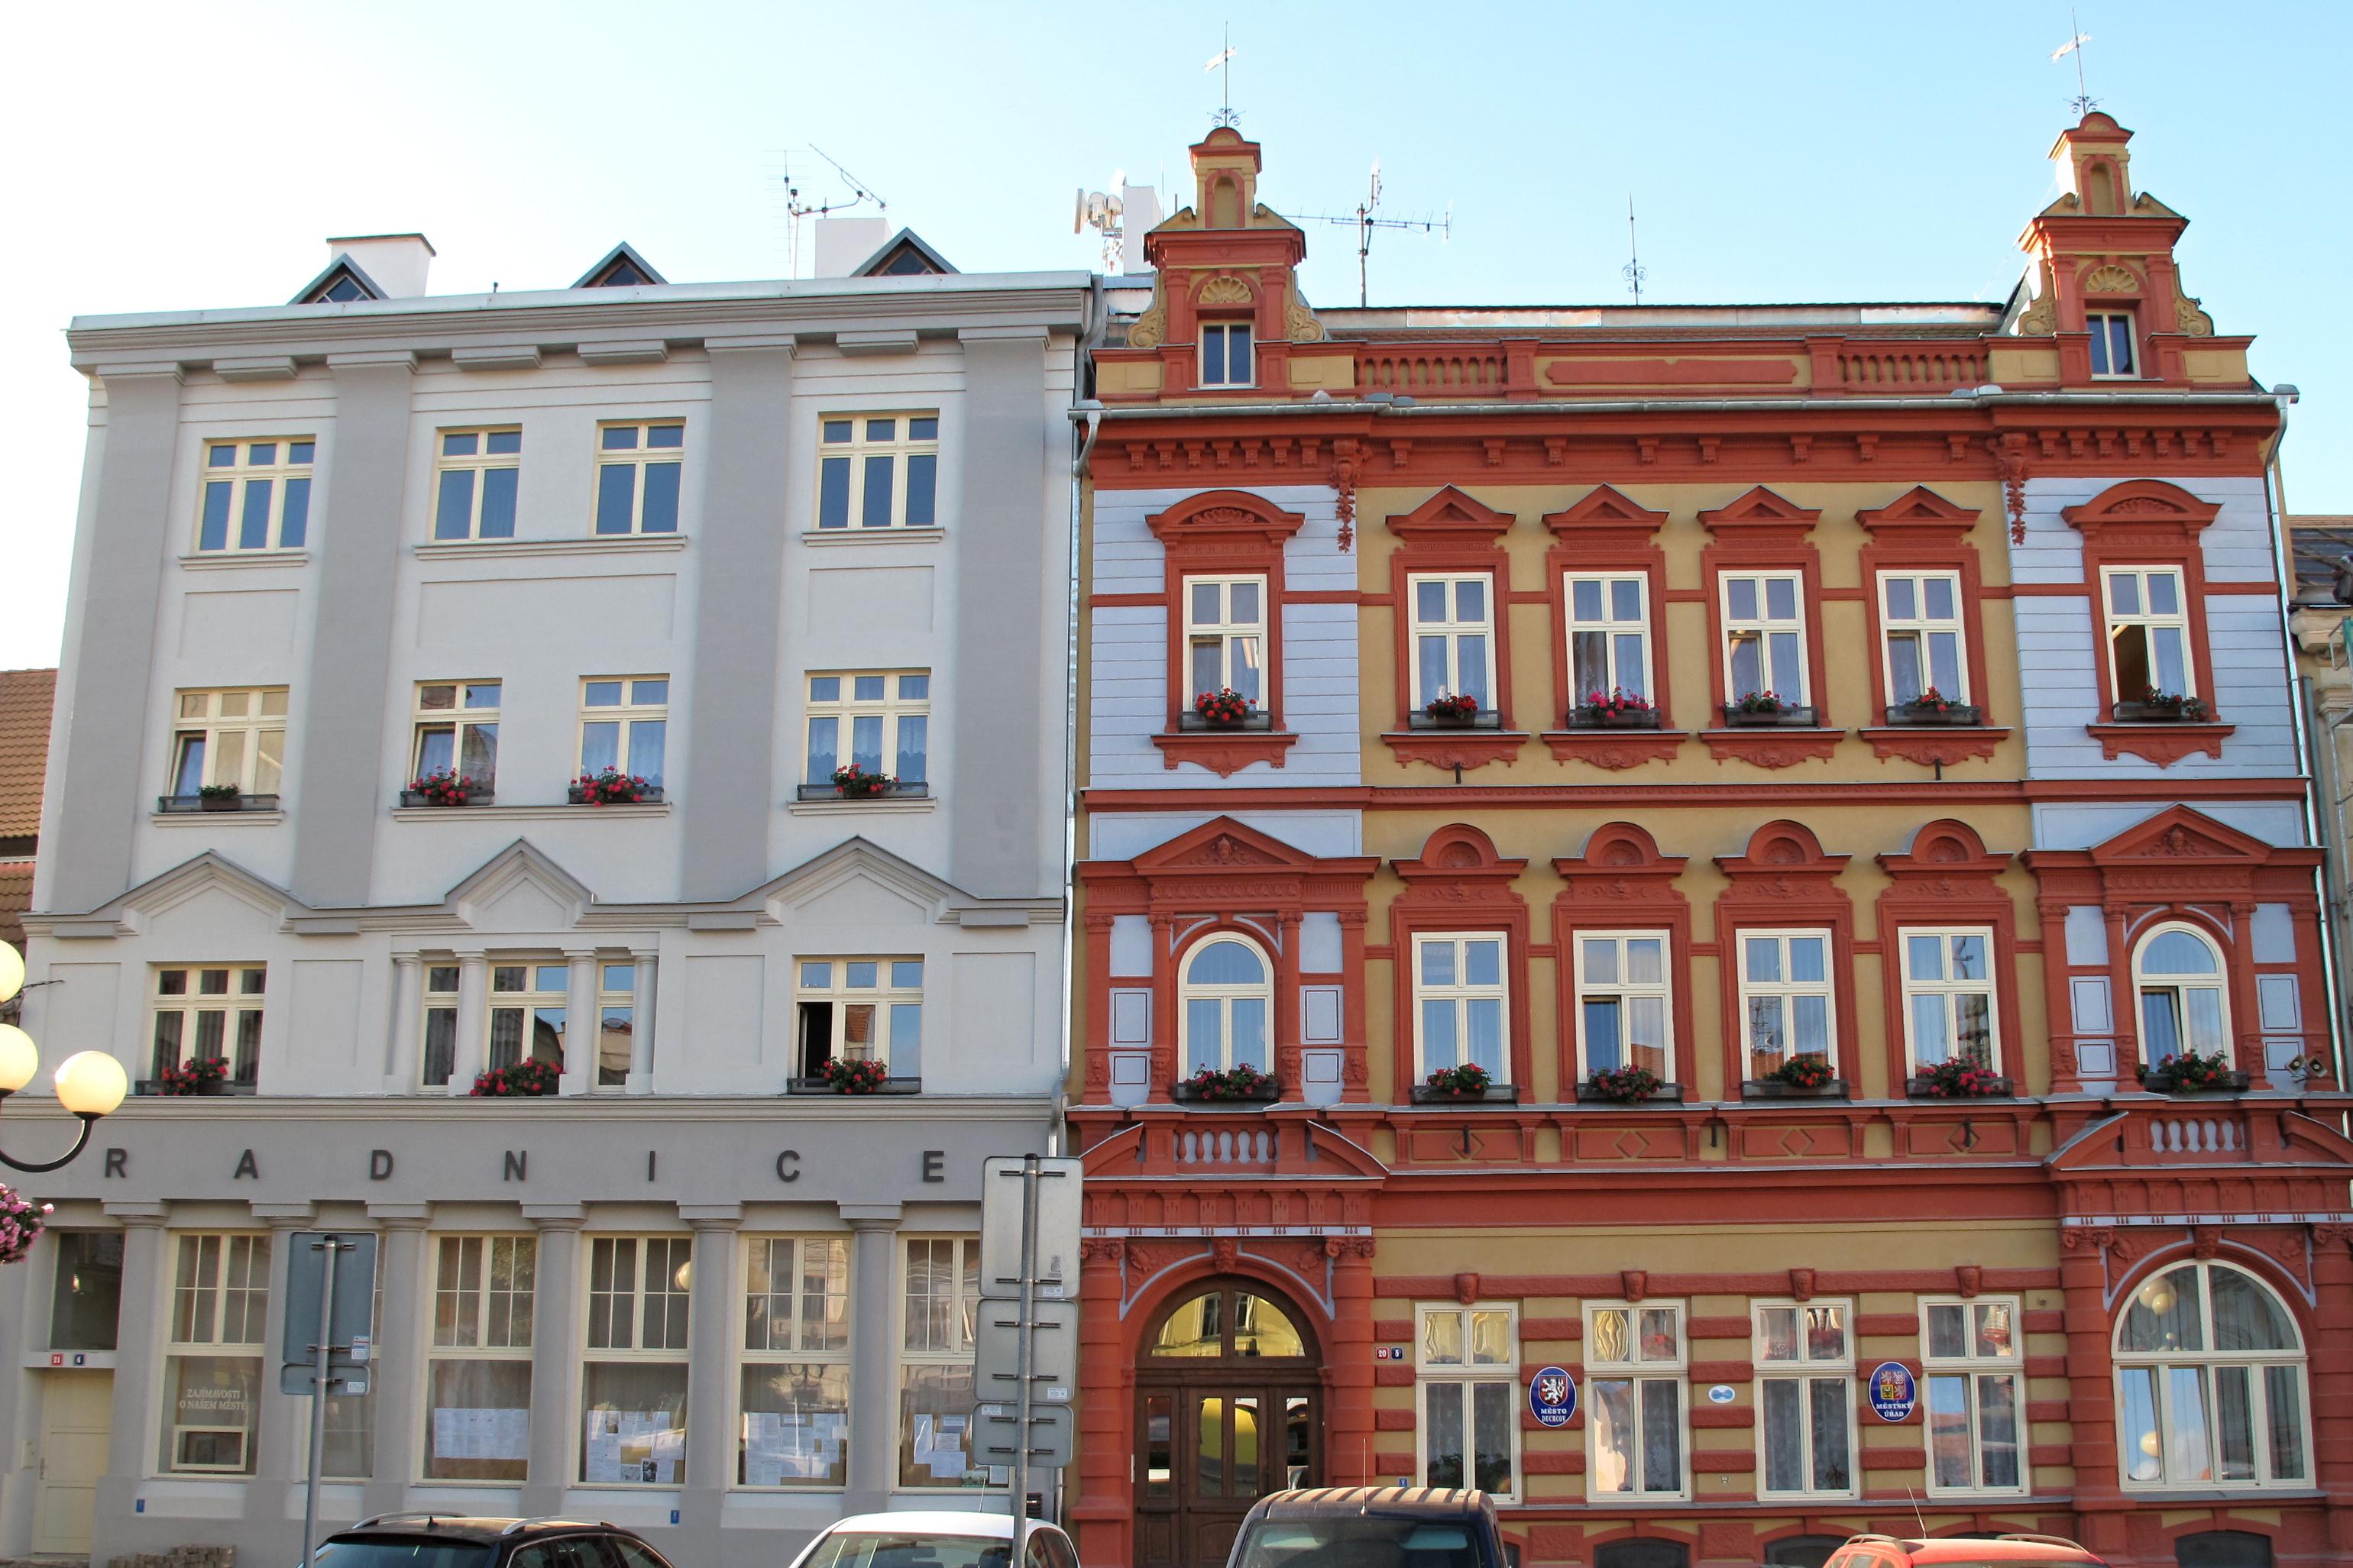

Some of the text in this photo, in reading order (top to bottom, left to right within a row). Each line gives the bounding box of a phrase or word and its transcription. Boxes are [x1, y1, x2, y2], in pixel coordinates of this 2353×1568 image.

[104, 1147, 944, 1182] RADNICE
[180, 1400, 186, 1409] O
[1876, 1401, 1911, 1409] MĚSTSKÝ
